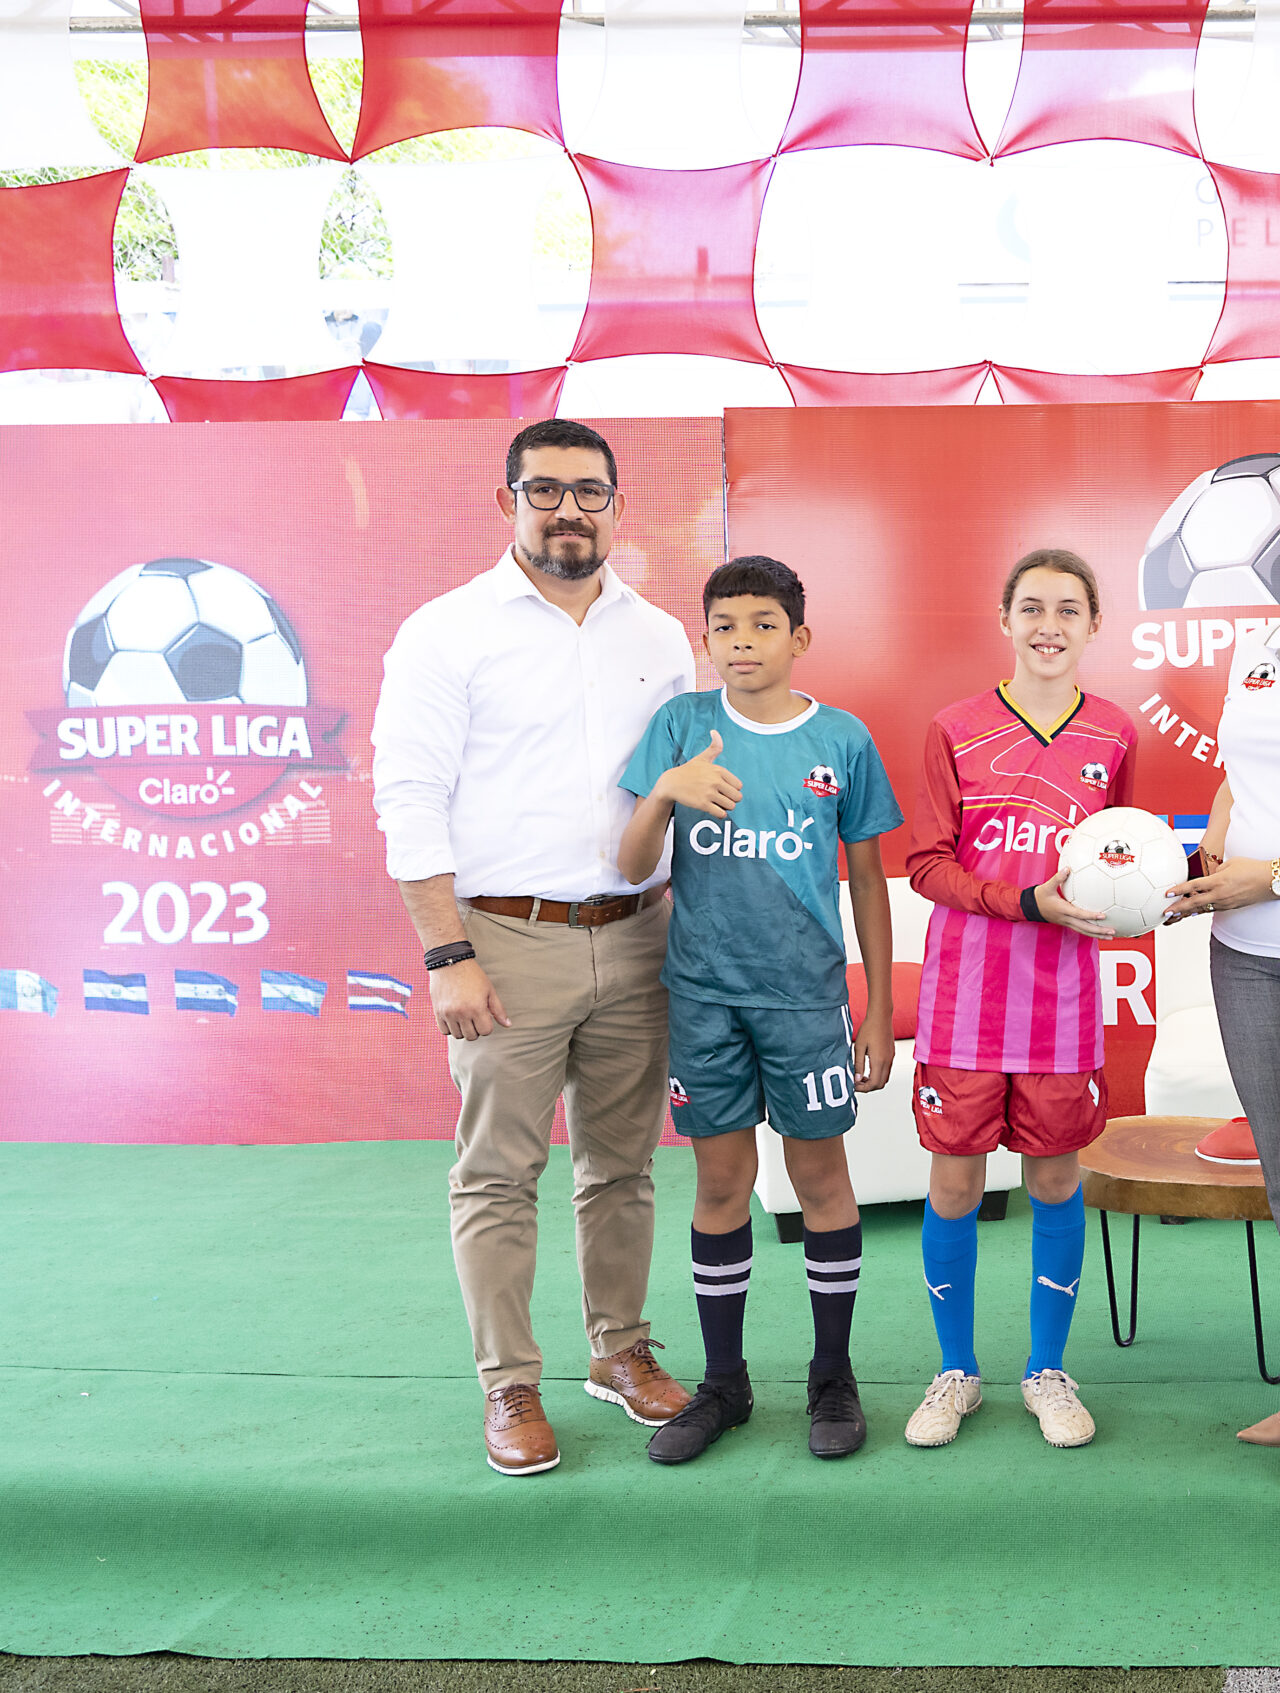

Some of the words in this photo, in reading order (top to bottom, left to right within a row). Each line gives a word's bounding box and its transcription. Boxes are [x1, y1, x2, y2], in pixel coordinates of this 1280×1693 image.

[57, 714, 201, 760] SUPER
[211, 715, 313, 759] LIGA
[139, 767, 235, 805] Claro
[807, 780, 825, 790] SUPER
[825, 785, 837, 795] LIGA
[1080, 776, 1097, 786] SUPER
[43, 779, 323, 860] INTERNACIONAL
[689, 809, 815, 861] Claro
[102, 881, 271, 945] 2023
[803, 1066, 849, 1111] 10
[930, 1105, 943, 1115] LIGA
